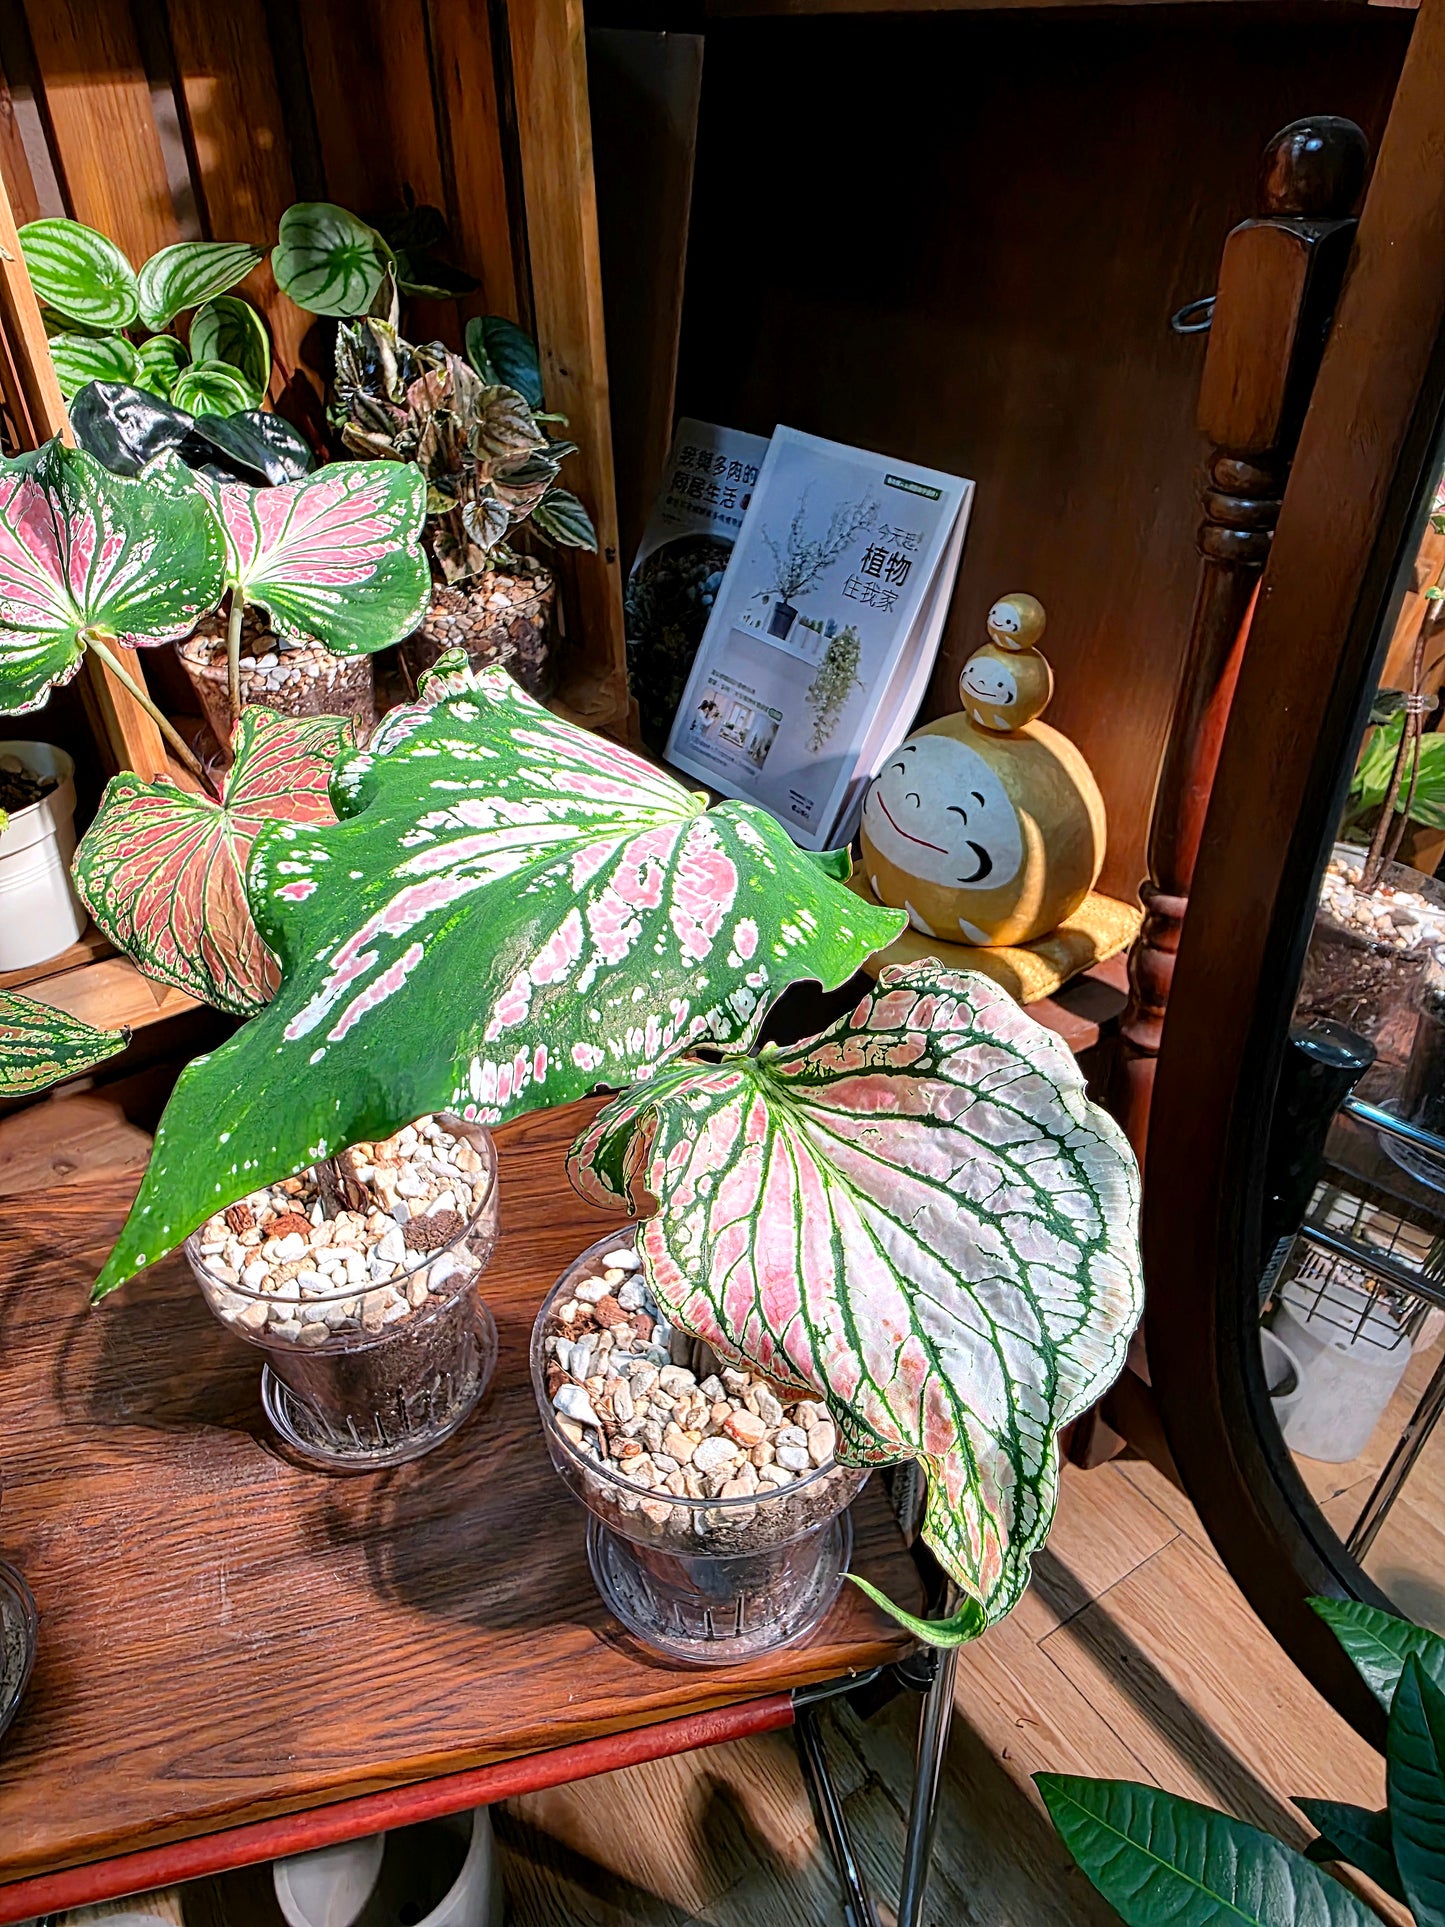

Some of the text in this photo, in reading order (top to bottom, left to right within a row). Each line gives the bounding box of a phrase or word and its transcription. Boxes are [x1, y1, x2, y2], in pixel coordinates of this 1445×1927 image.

[861, 542, 912, 587] 植物
[841, 573, 899, 613] 住我家
